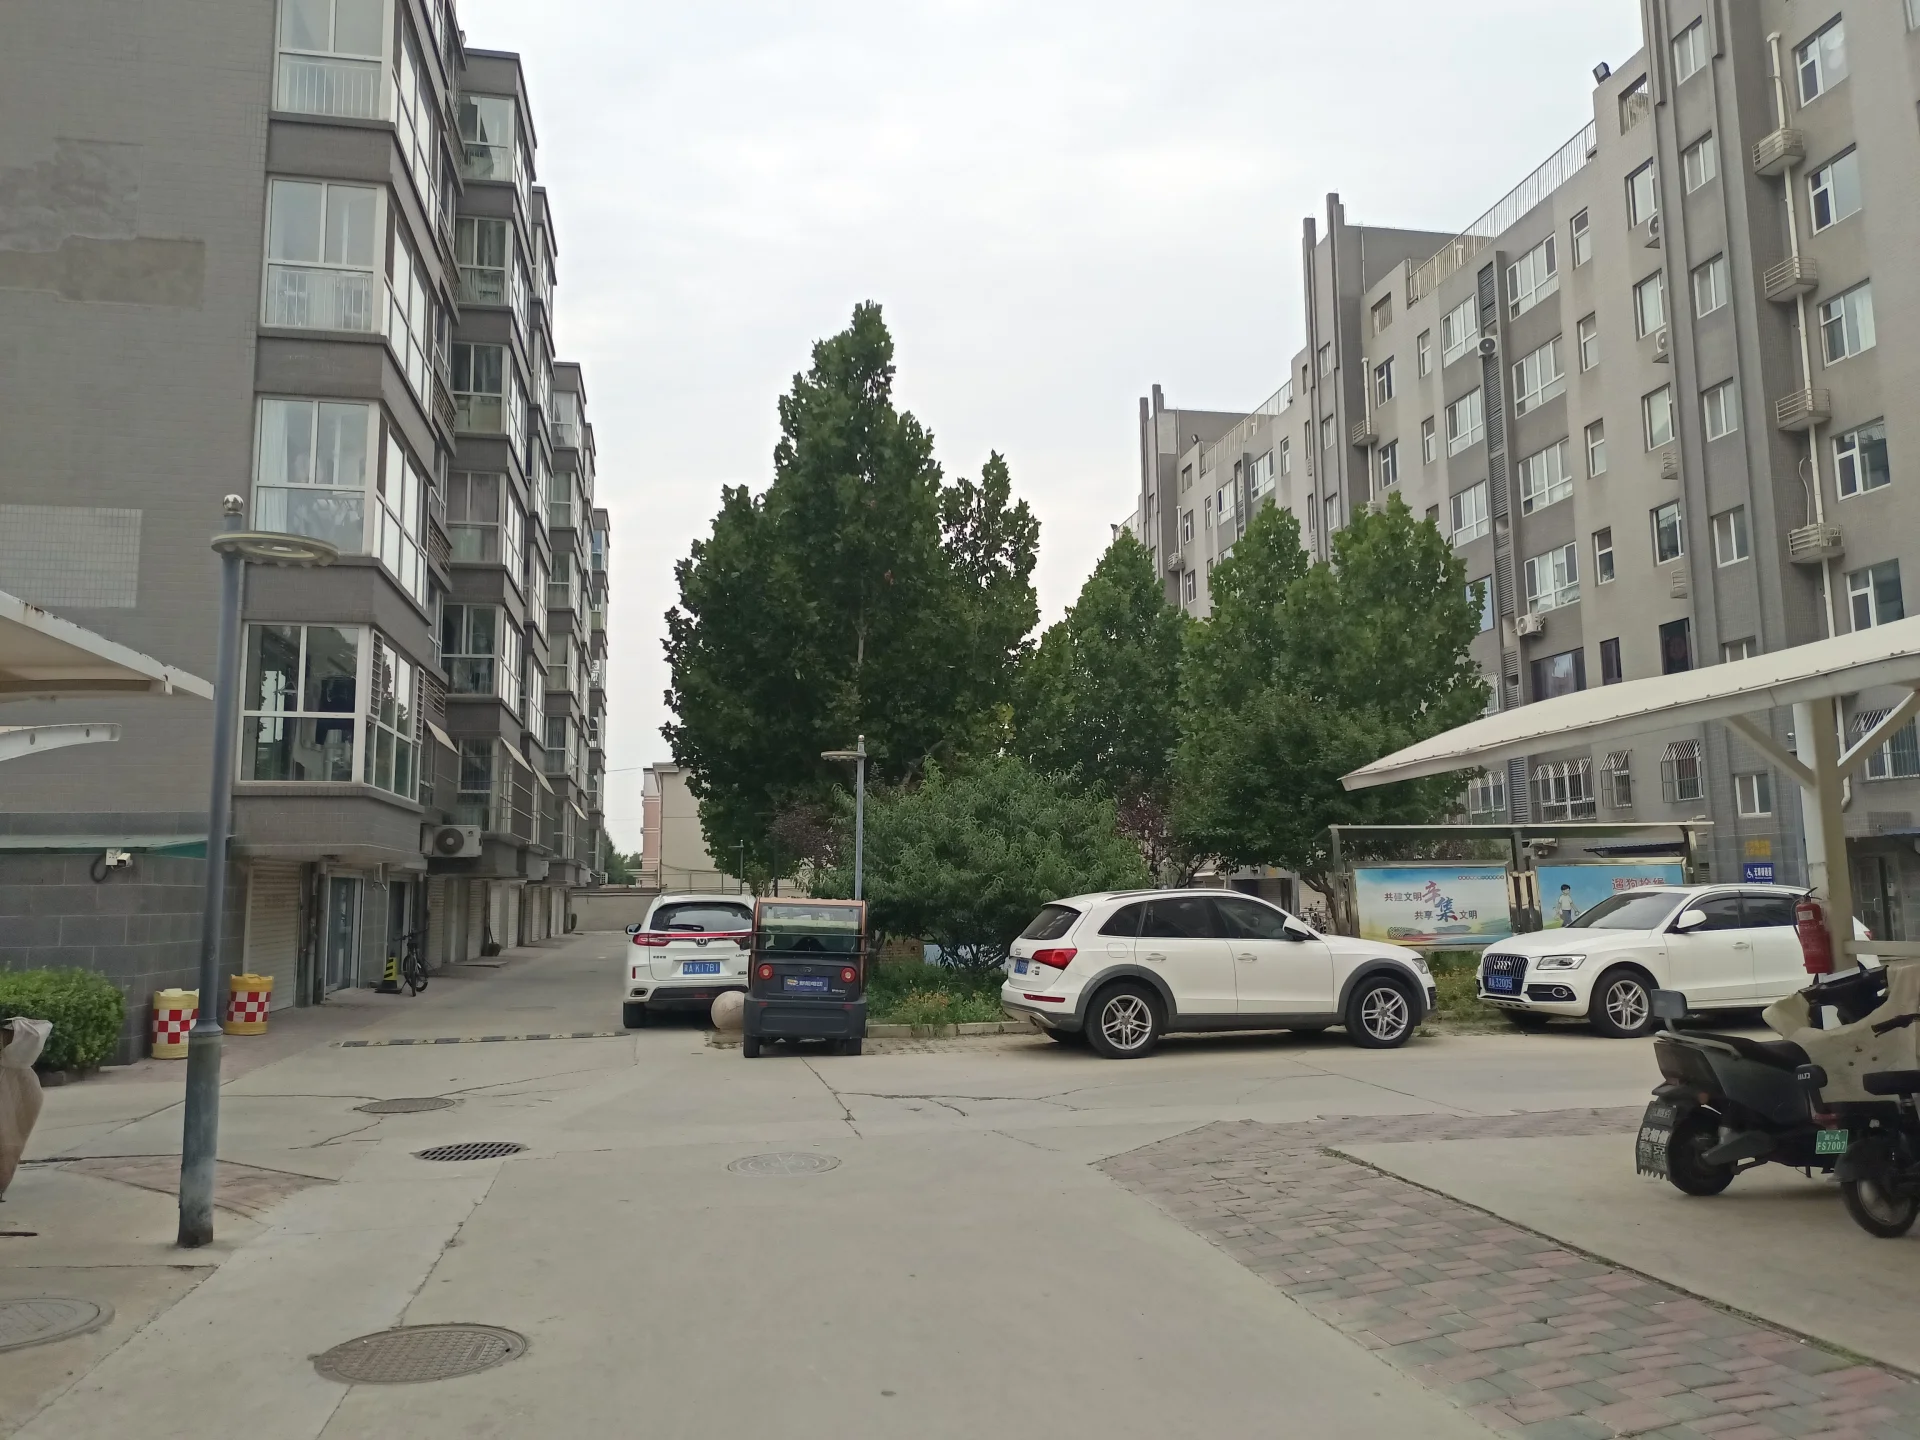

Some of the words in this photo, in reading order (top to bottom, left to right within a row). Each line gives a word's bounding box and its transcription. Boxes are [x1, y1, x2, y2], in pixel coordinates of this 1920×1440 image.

[1384, 892, 1423, 902] 共建文明
[1414, 910, 1434, 920] 共享
[1459, 909, 1478, 920] 文明
